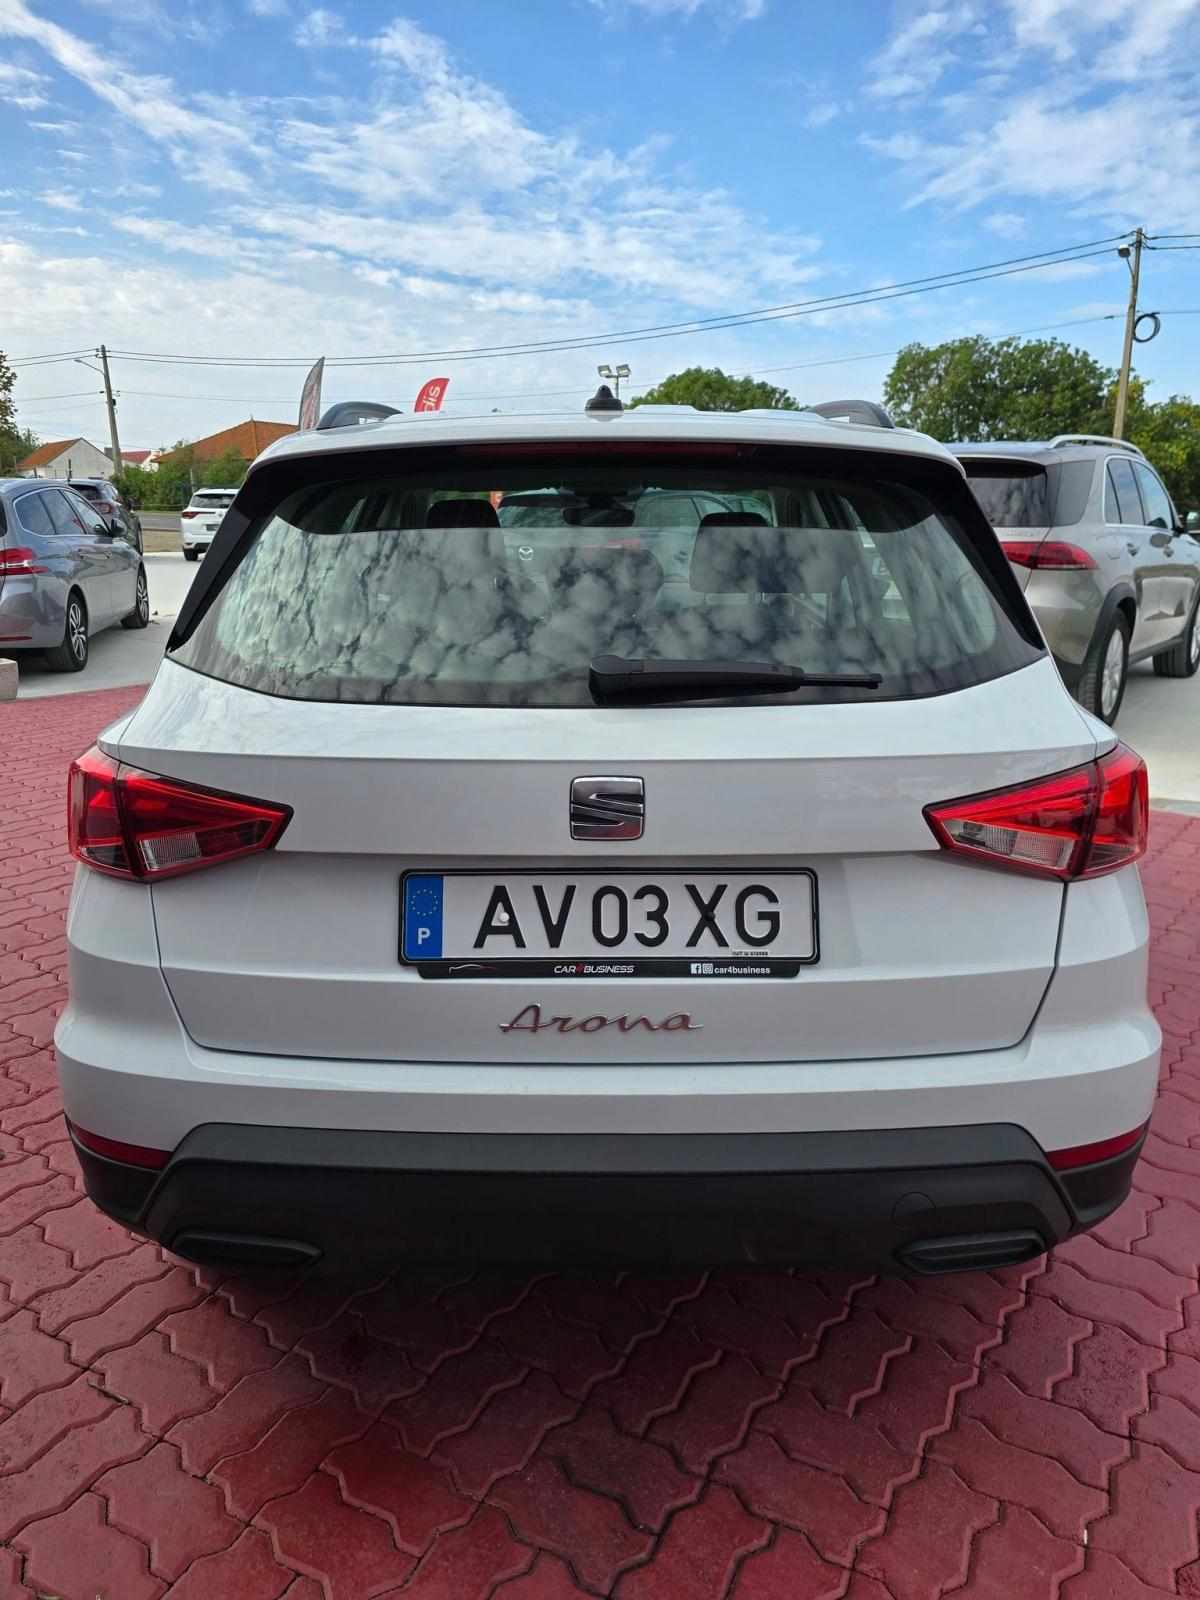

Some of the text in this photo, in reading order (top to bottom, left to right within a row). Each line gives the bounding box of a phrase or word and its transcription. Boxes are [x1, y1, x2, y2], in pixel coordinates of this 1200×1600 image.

[473, 884, 780, 948] AV 03 XG
[417, 927, 431, 945] P
[714, 965, 771, 975] car4business
[499, 1002, 704, 1033] Arona
